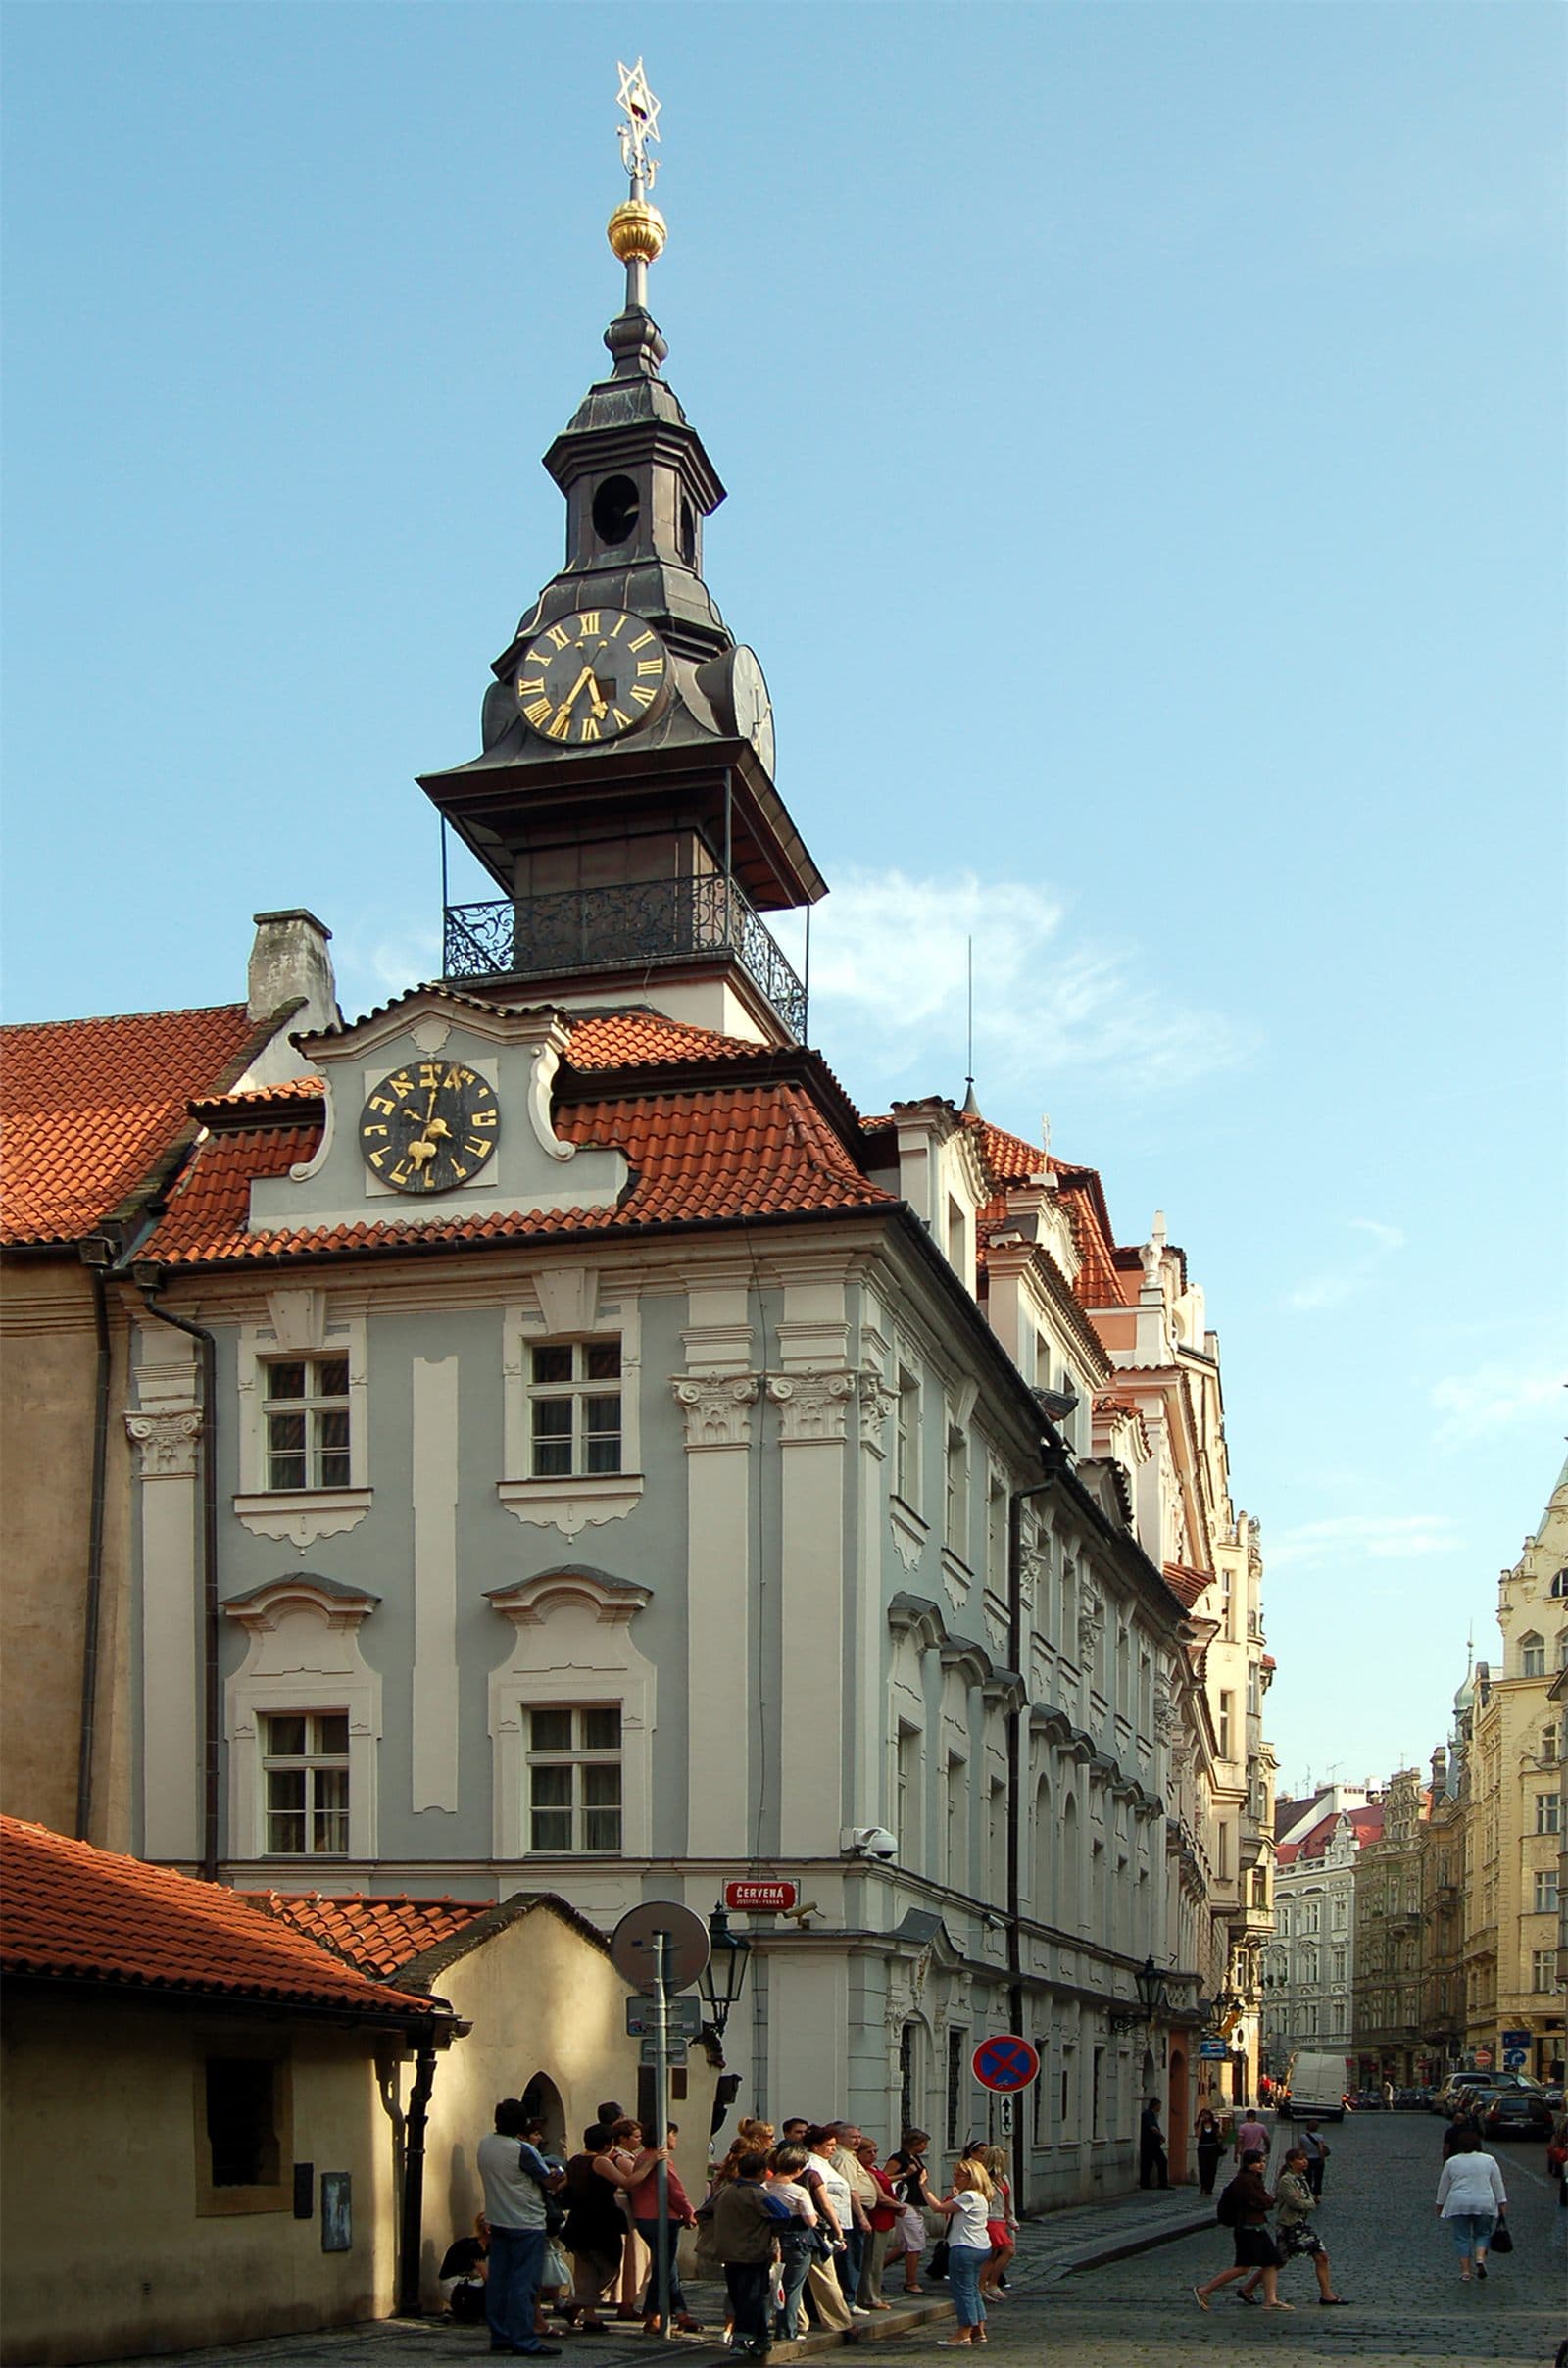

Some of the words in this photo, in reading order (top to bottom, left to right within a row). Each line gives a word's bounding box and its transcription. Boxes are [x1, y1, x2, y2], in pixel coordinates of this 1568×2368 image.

[578, 612, 600, 637] XII
[611, 615, 628, 638] I
[546, 624, 571, 651] XI
[628, 630, 656, 653] II
[525, 649, 553, 667] X
[637, 657, 663, 677] III
[518, 676, 545, 697] IX
[630, 684, 657, 708] IV
[523, 697, 554, 729] VIII
[612, 708, 633, 730] V
[581, 717, 602, 741] VI
[736, 1886, 784, 1898] ČERVENÁ
